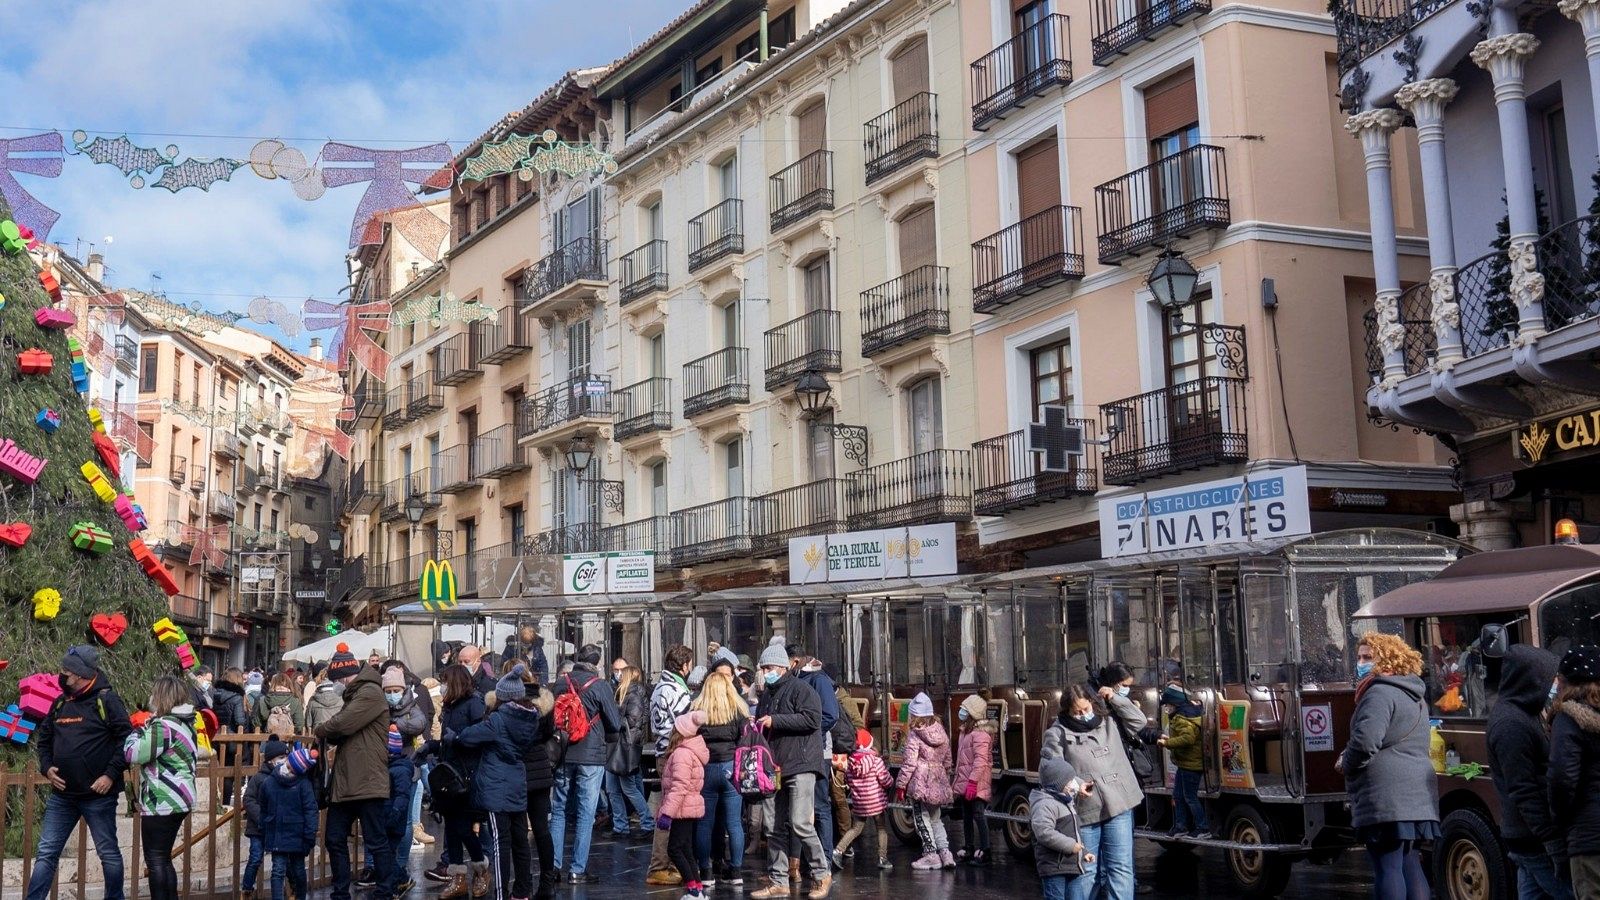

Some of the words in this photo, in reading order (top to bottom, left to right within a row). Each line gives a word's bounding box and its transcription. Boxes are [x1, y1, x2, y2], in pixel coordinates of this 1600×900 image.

[1118, 501, 1286, 551] PINARES
[827, 543, 850, 557] CAJA
[851, 541, 882, 555] RURAL
[921, 538, 939, 547] AÑOS
[829, 559, 841, 570] DE
[843, 555, 881, 569] TERUEL
[578, 568, 597, 579] CSIF
